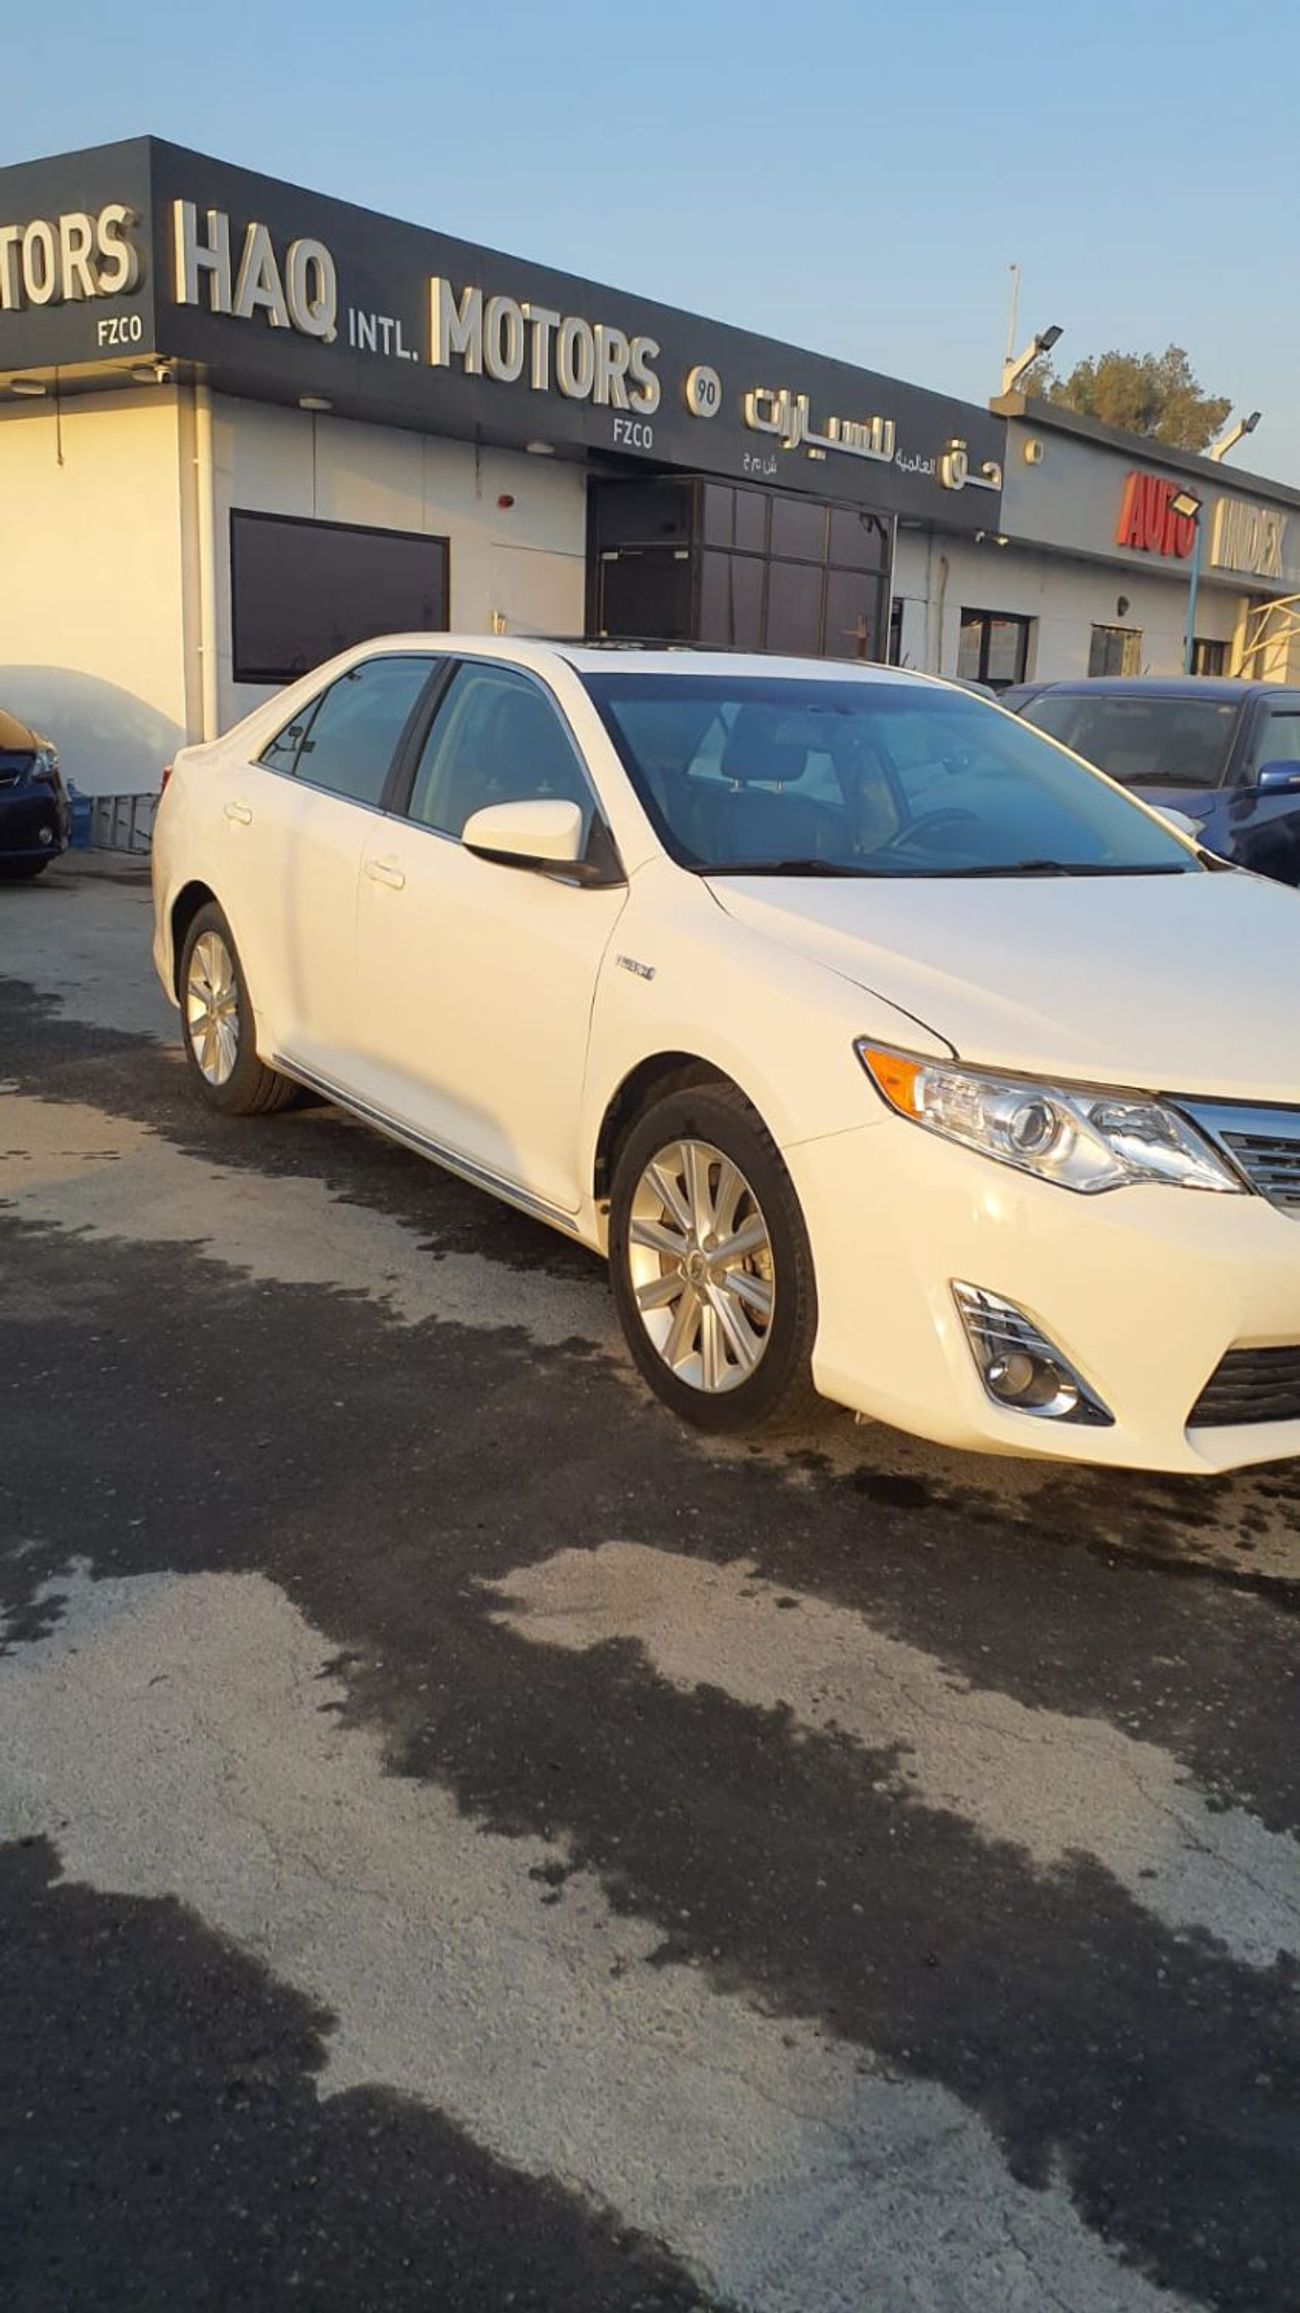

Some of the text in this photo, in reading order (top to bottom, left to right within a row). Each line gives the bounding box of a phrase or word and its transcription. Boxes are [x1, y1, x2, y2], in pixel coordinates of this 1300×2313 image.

[98, 315, 142, 346] FZCO
[173, 199, 661, 415] HAQ INTL. MOTORS
[698, 378, 715, 404] 90
[612, 418, 653, 448] FZCO
[743, 387, 896, 462] للسيارات
[1118, 471, 1196, 558] AUTO
